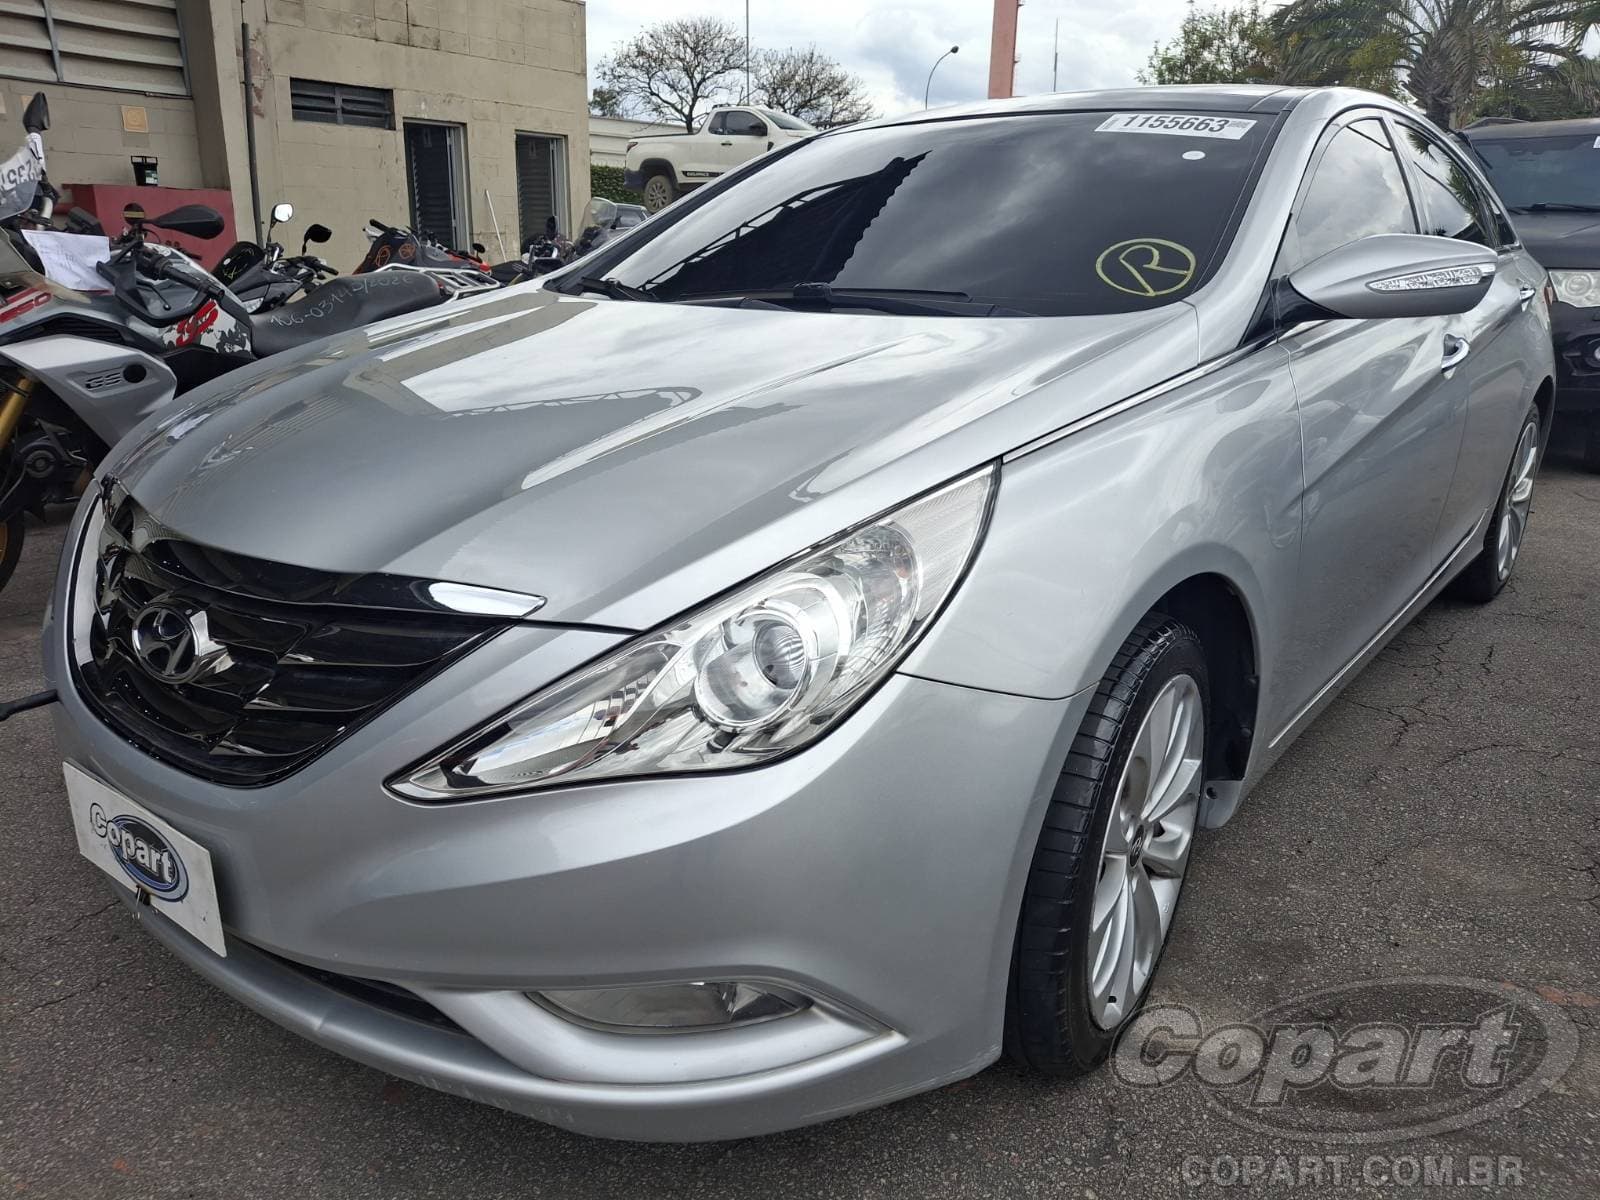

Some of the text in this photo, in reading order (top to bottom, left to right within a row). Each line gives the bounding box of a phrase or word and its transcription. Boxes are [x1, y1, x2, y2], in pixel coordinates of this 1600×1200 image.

[1122, 114, 1230, 134] 1155663
[85, 371, 121, 389] GS
[89, 802, 174, 884] Copart
